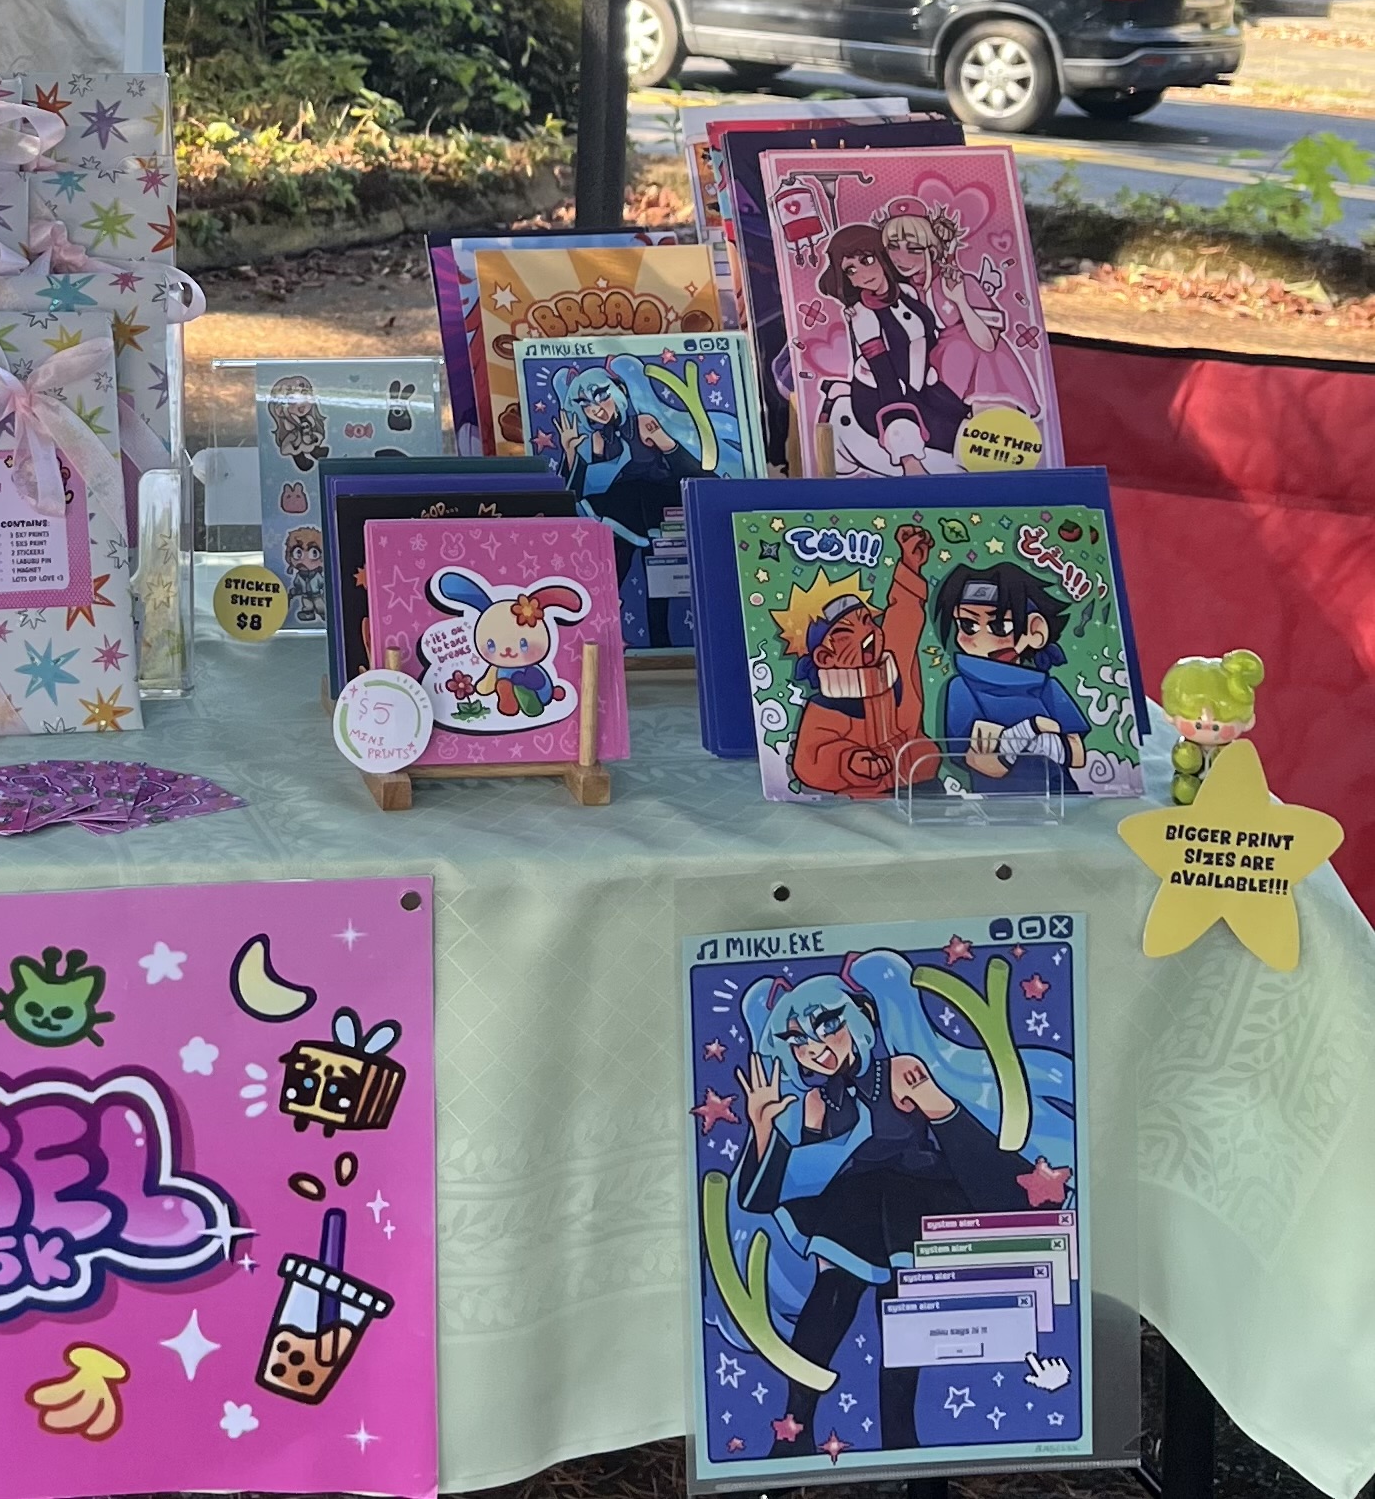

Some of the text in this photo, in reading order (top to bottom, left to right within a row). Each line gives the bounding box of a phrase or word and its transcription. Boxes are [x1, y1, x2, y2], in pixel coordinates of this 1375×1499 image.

[531, 292, 662, 338] BREAD
[540, 341, 595, 356] MIKU.EXE
[963, 428, 1043, 453] LOOK THRU
[969, 444, 991, 458] ME
[225, 578, 280, 594] STICKER
[230, 594, 273, 608] SHEET
[236, 612, 263, 631] $8
[451, 626, 465, 636] ok
[431, 635, 467, 654] to take
[437, 645, 472, 663] breaks
[359, 691, 394, 725] $5
[349, 729, 385, 746] MINI
[367, 747, 410, 760] PRINTS
[1166, 825, 1294, 851] BIGGER PRINT
[1184, 849, 1274, 871] SIZES ARE
[1170, 870, 1289, 895] AVAILABLE!!!
[725, 931, 825, 958] MIKU.EXE
